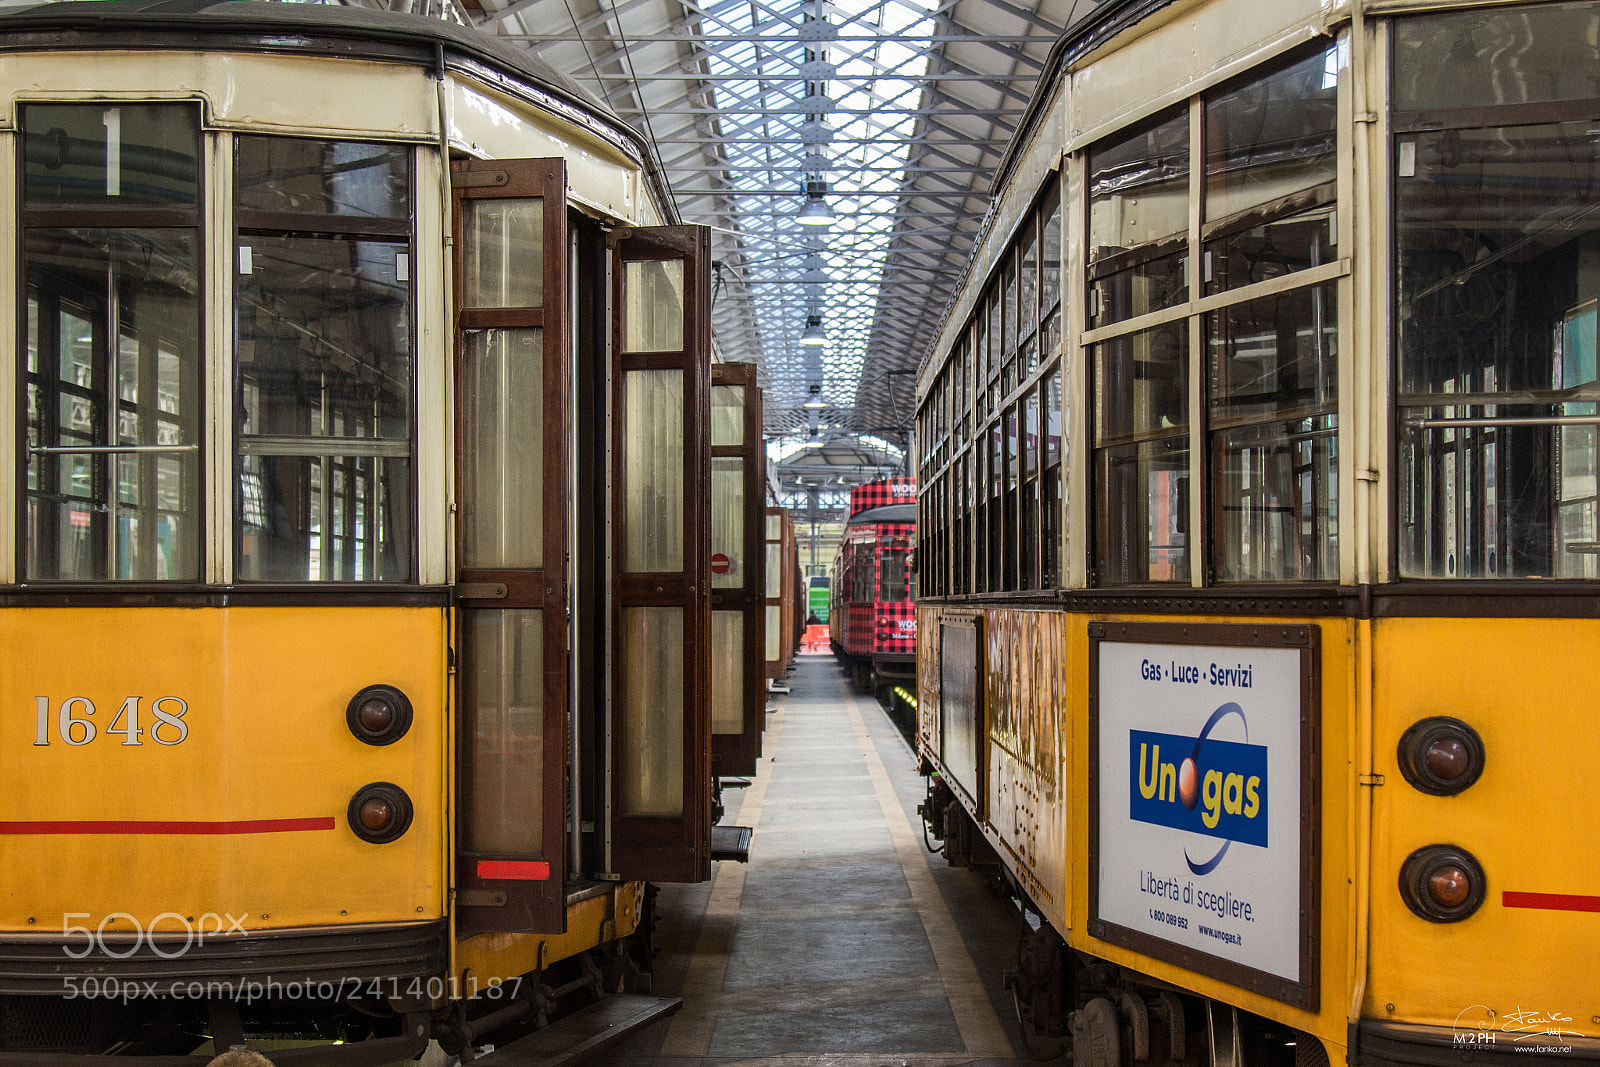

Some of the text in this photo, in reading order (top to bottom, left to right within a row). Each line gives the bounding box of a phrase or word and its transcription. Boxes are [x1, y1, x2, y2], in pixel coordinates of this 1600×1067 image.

[1141, 659, 1252, 688] Gas Luce Servizi
[33, 696, 189, 746] 1648
[1139, 742, 1260, 829] Unogas
[1140, 870, 1255, 922] Libertà di scegliere.
[1153, 909, 1242, 946] 800 089 952 www.unogas.it
